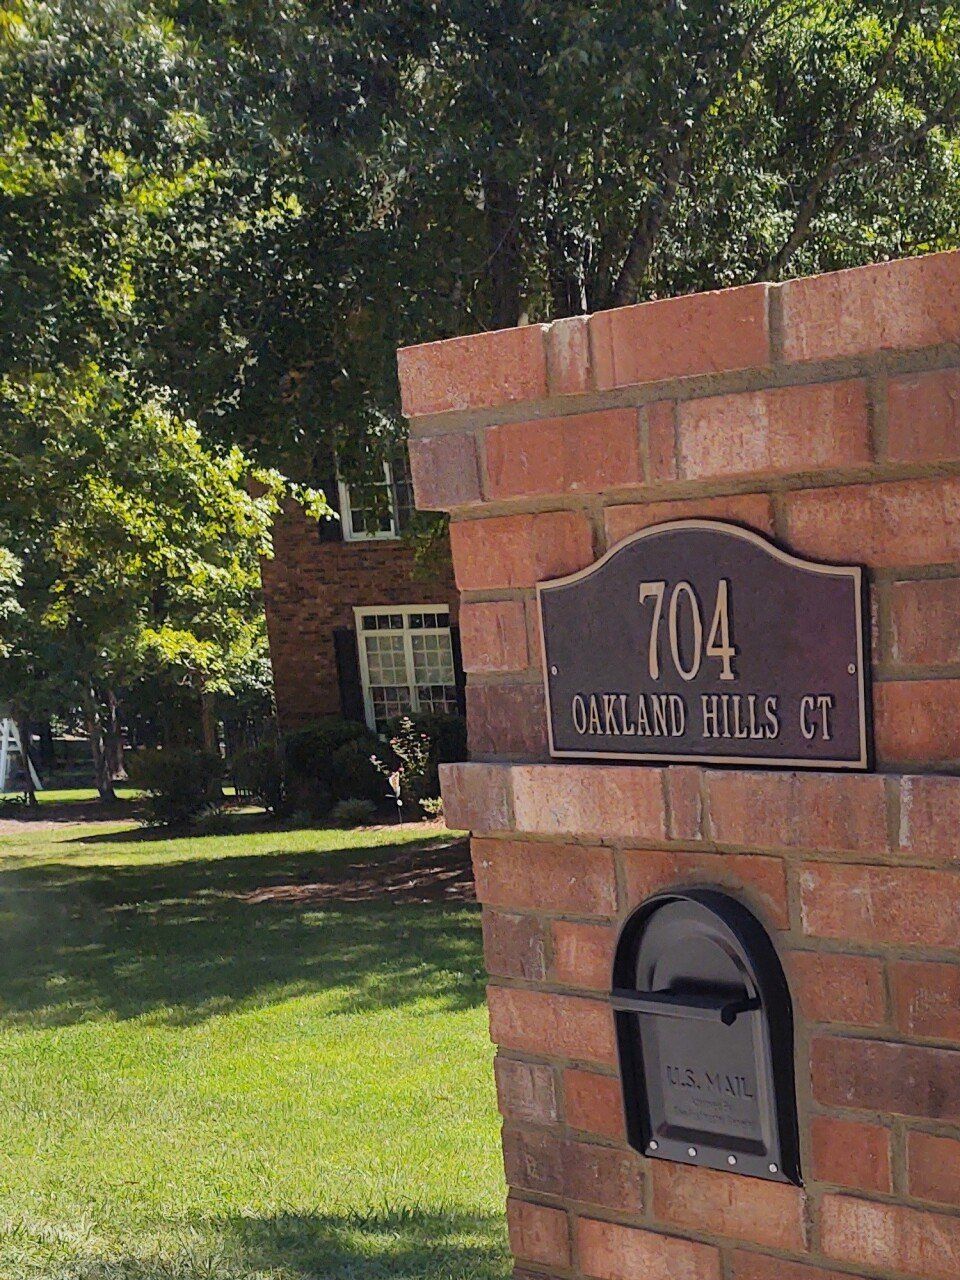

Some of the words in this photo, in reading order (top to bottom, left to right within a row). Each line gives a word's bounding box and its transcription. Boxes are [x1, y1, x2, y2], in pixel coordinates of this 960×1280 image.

[639, 579, 736, 681] 704
[572, 694, 686, 737] OAKLAND
[701, 694, 779, 739] HILLS
[799, 695, 832, 740] CT
[667, 1065, 701, 1089] U.S.
[704, 1072, 753, 1097] MAIL
